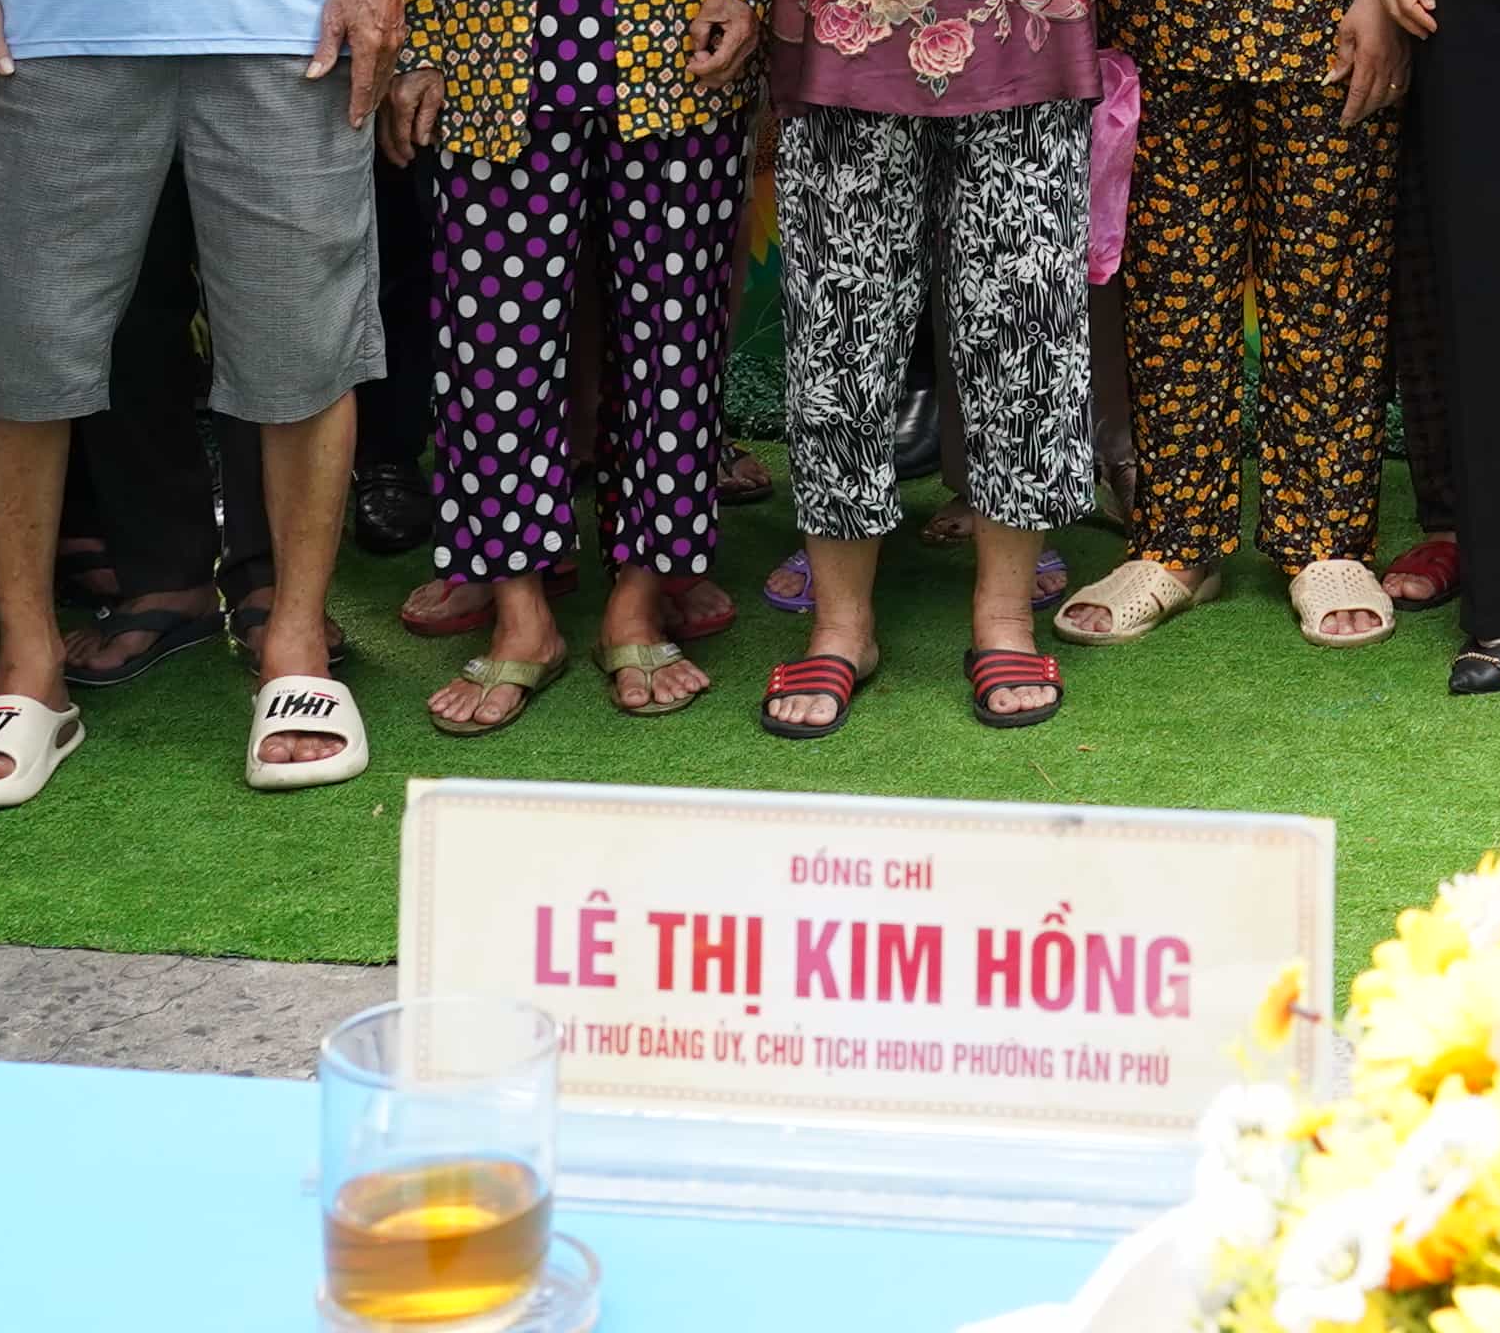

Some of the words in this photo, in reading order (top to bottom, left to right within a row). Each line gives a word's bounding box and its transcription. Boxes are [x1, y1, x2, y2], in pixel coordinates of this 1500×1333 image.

[883, 854, 935, 891] CHÍ
[535, 889, 618, 988] LÊ
[646, 910, 764, 1016] THỊ
[795, 918, 944, 1005] KIM
[975, 900, 1191, 1019] HỒNG
[584, 1022, 633, 1056] THƯ
[638, 1015, 705, 1061] ĐẢNG
[814, 1035, 867, 1077] TỊCH
[875, 1038, 944, 1074] HĐND
[1062, 1042, 1111, 1083] TÂN
